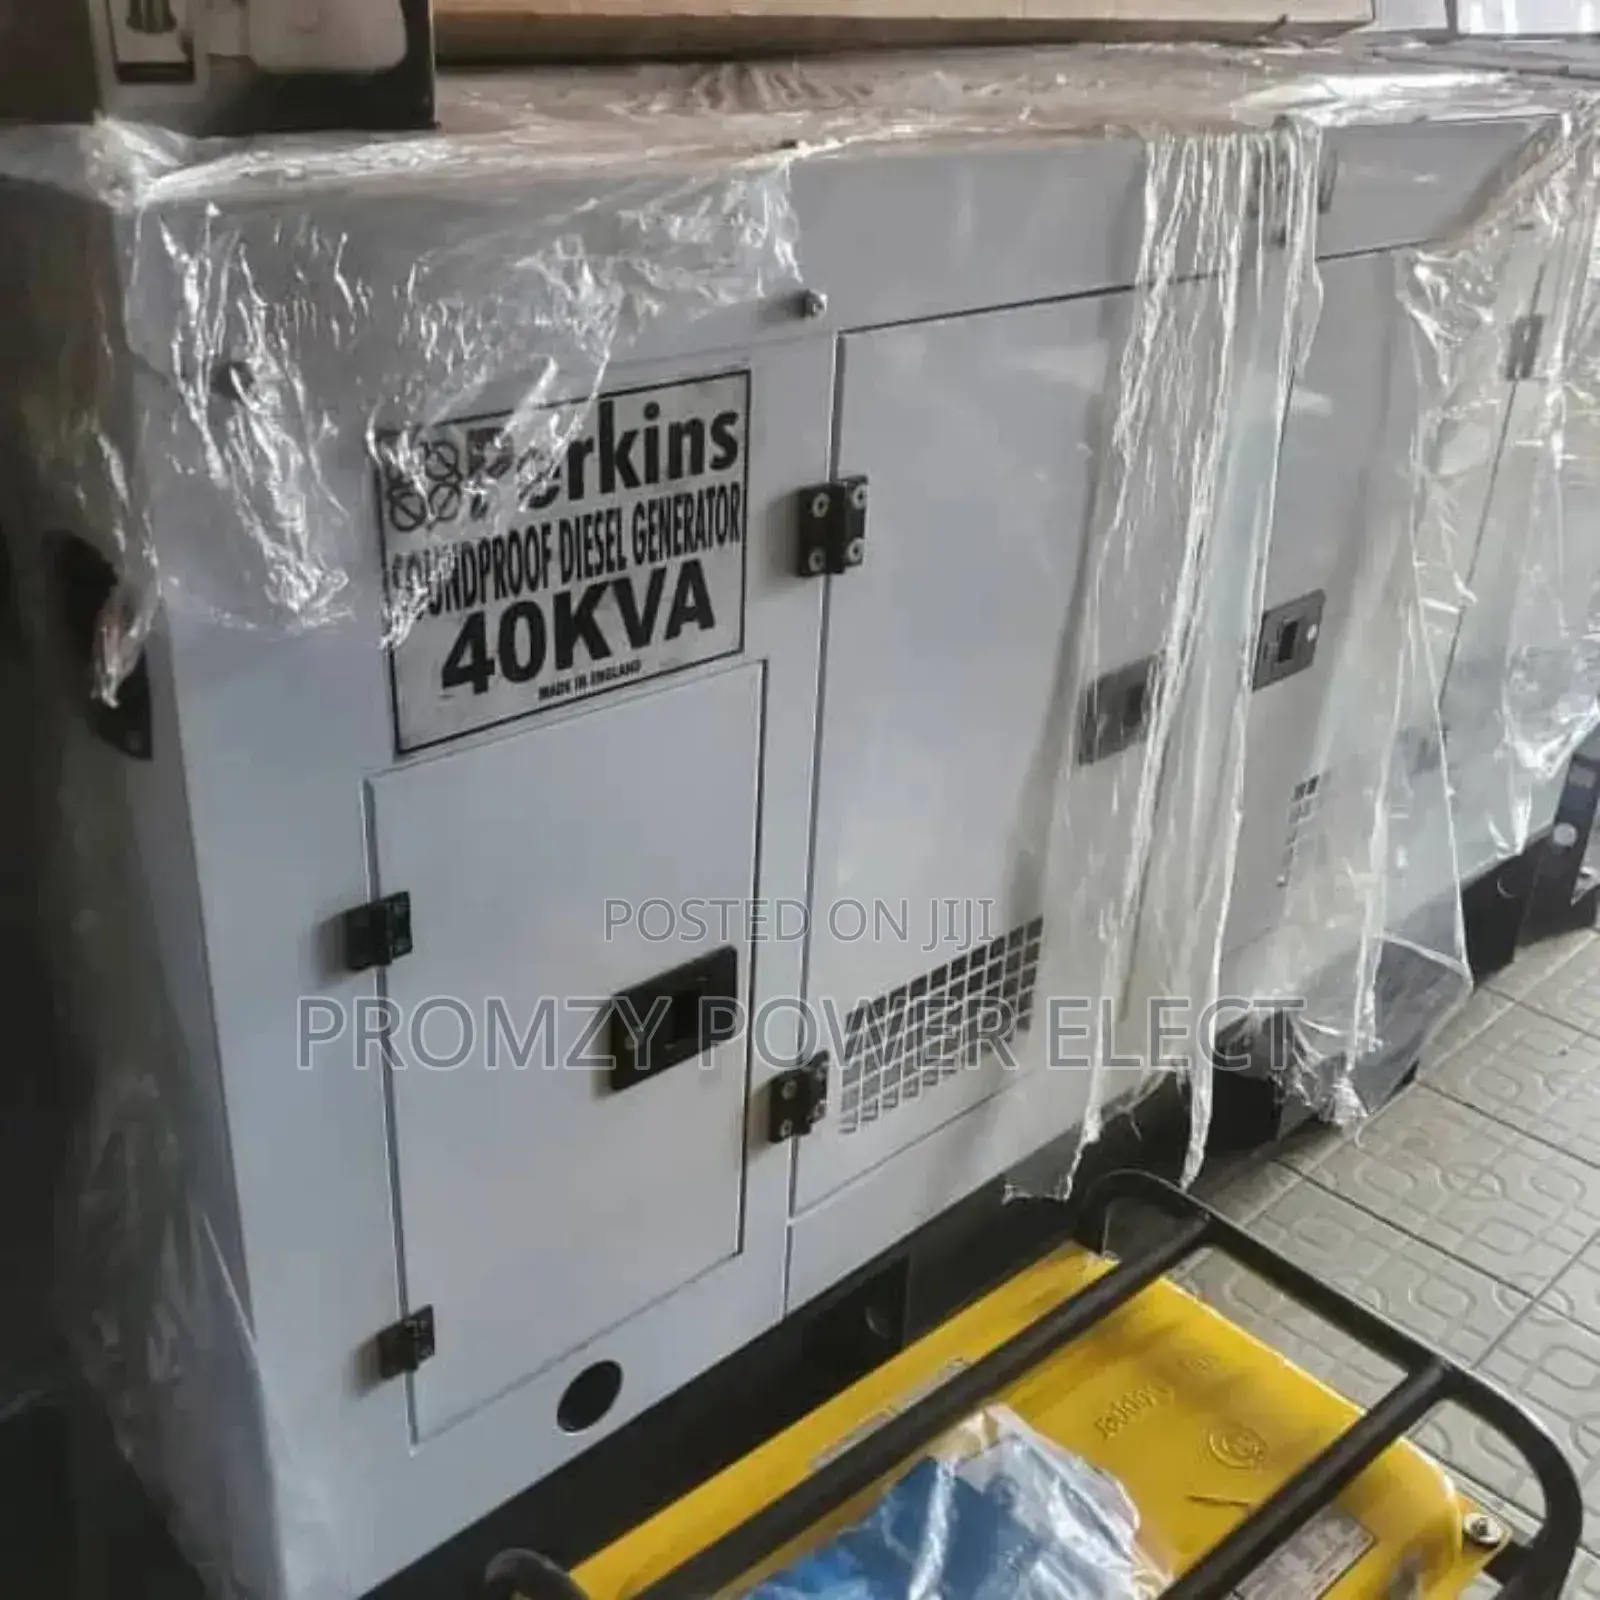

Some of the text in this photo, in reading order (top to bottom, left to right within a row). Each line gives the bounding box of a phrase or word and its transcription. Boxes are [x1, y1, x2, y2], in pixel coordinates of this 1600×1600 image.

[559, 507, 627, 586] DIESEL
[632, 482, 741, 567] GENERATOR
[441, 559, 716, 695] 40KVA
